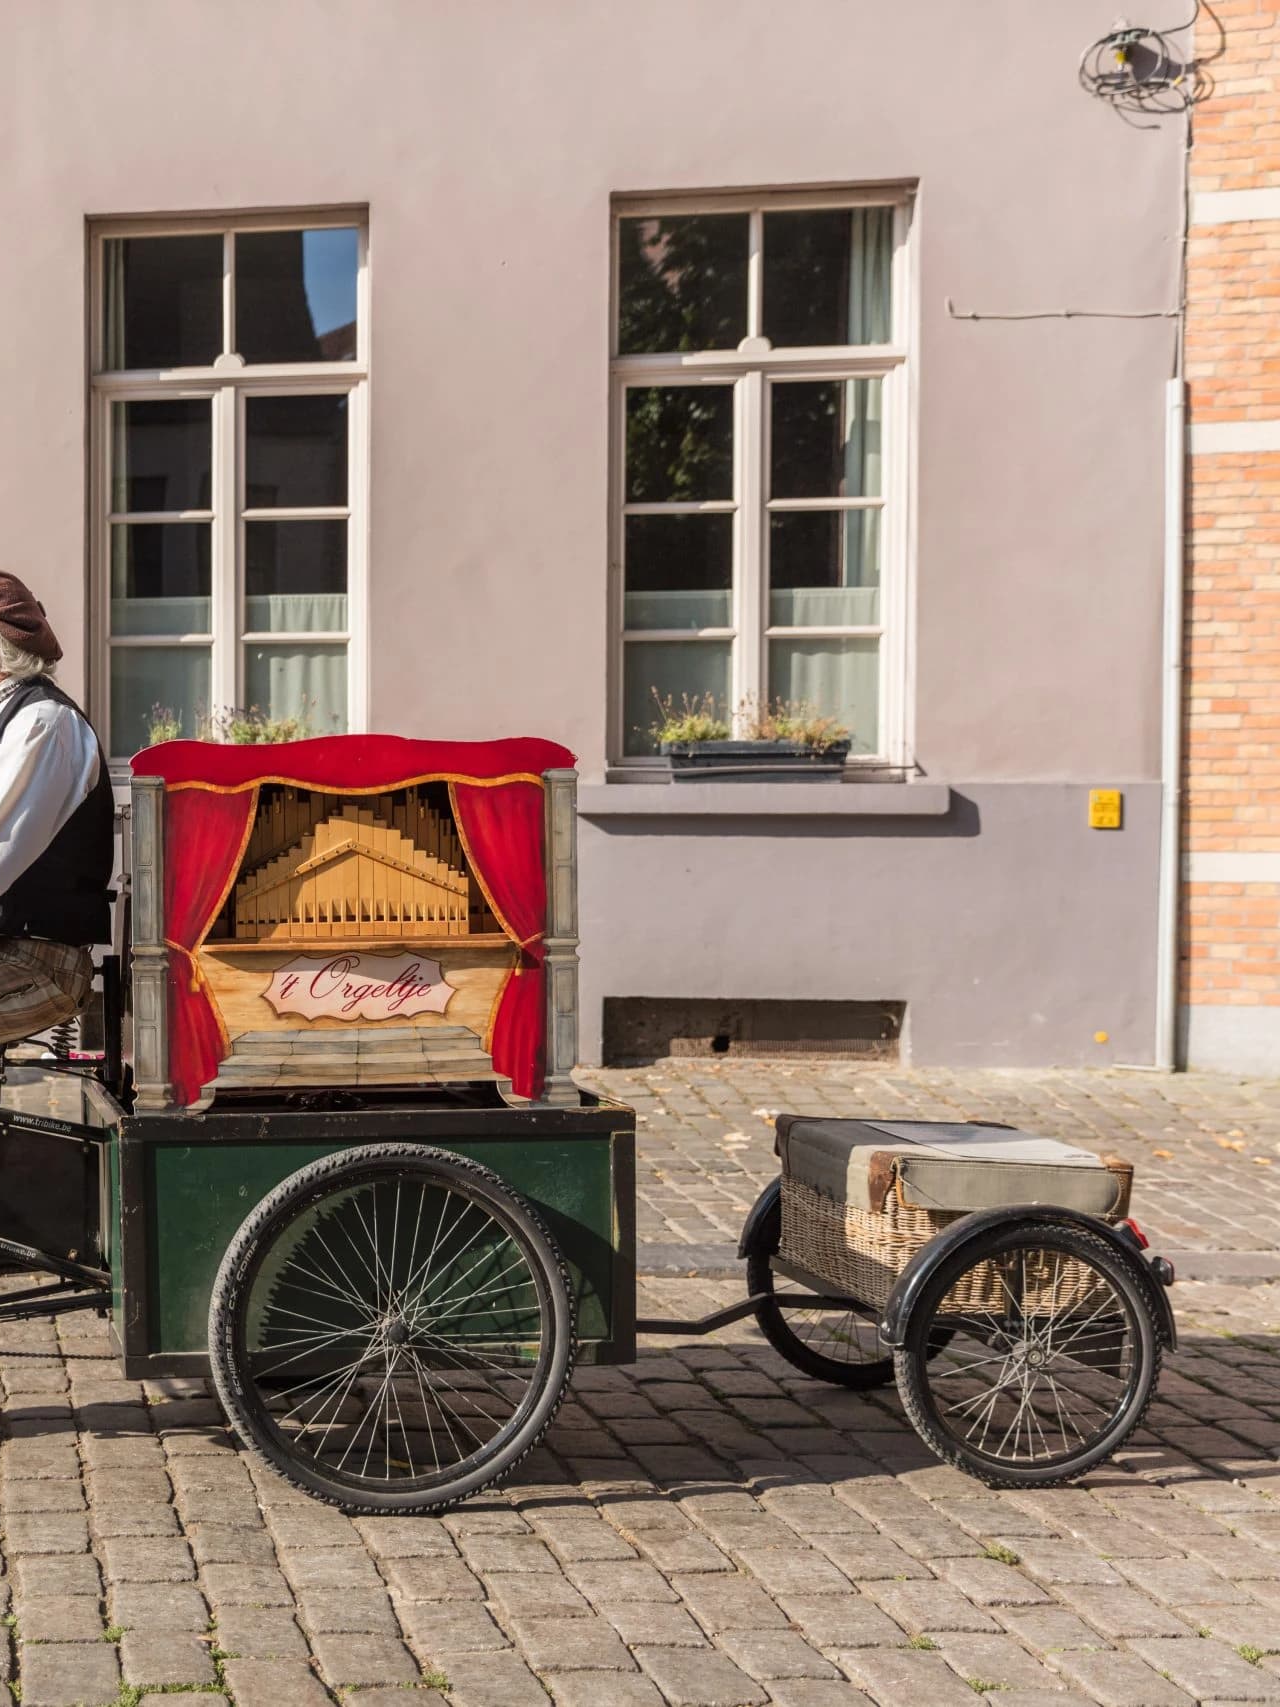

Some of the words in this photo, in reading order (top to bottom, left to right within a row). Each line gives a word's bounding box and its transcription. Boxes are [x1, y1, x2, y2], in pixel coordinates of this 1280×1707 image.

[279, 973, 303, 1001] 't
[309, 955, 432, 1012] Orgeltje
[13, 1114, 72, 1133] www.tribike.be
[228, 1287, 238, 1310] CX
[236, 1239, 258, 1281] COMP
